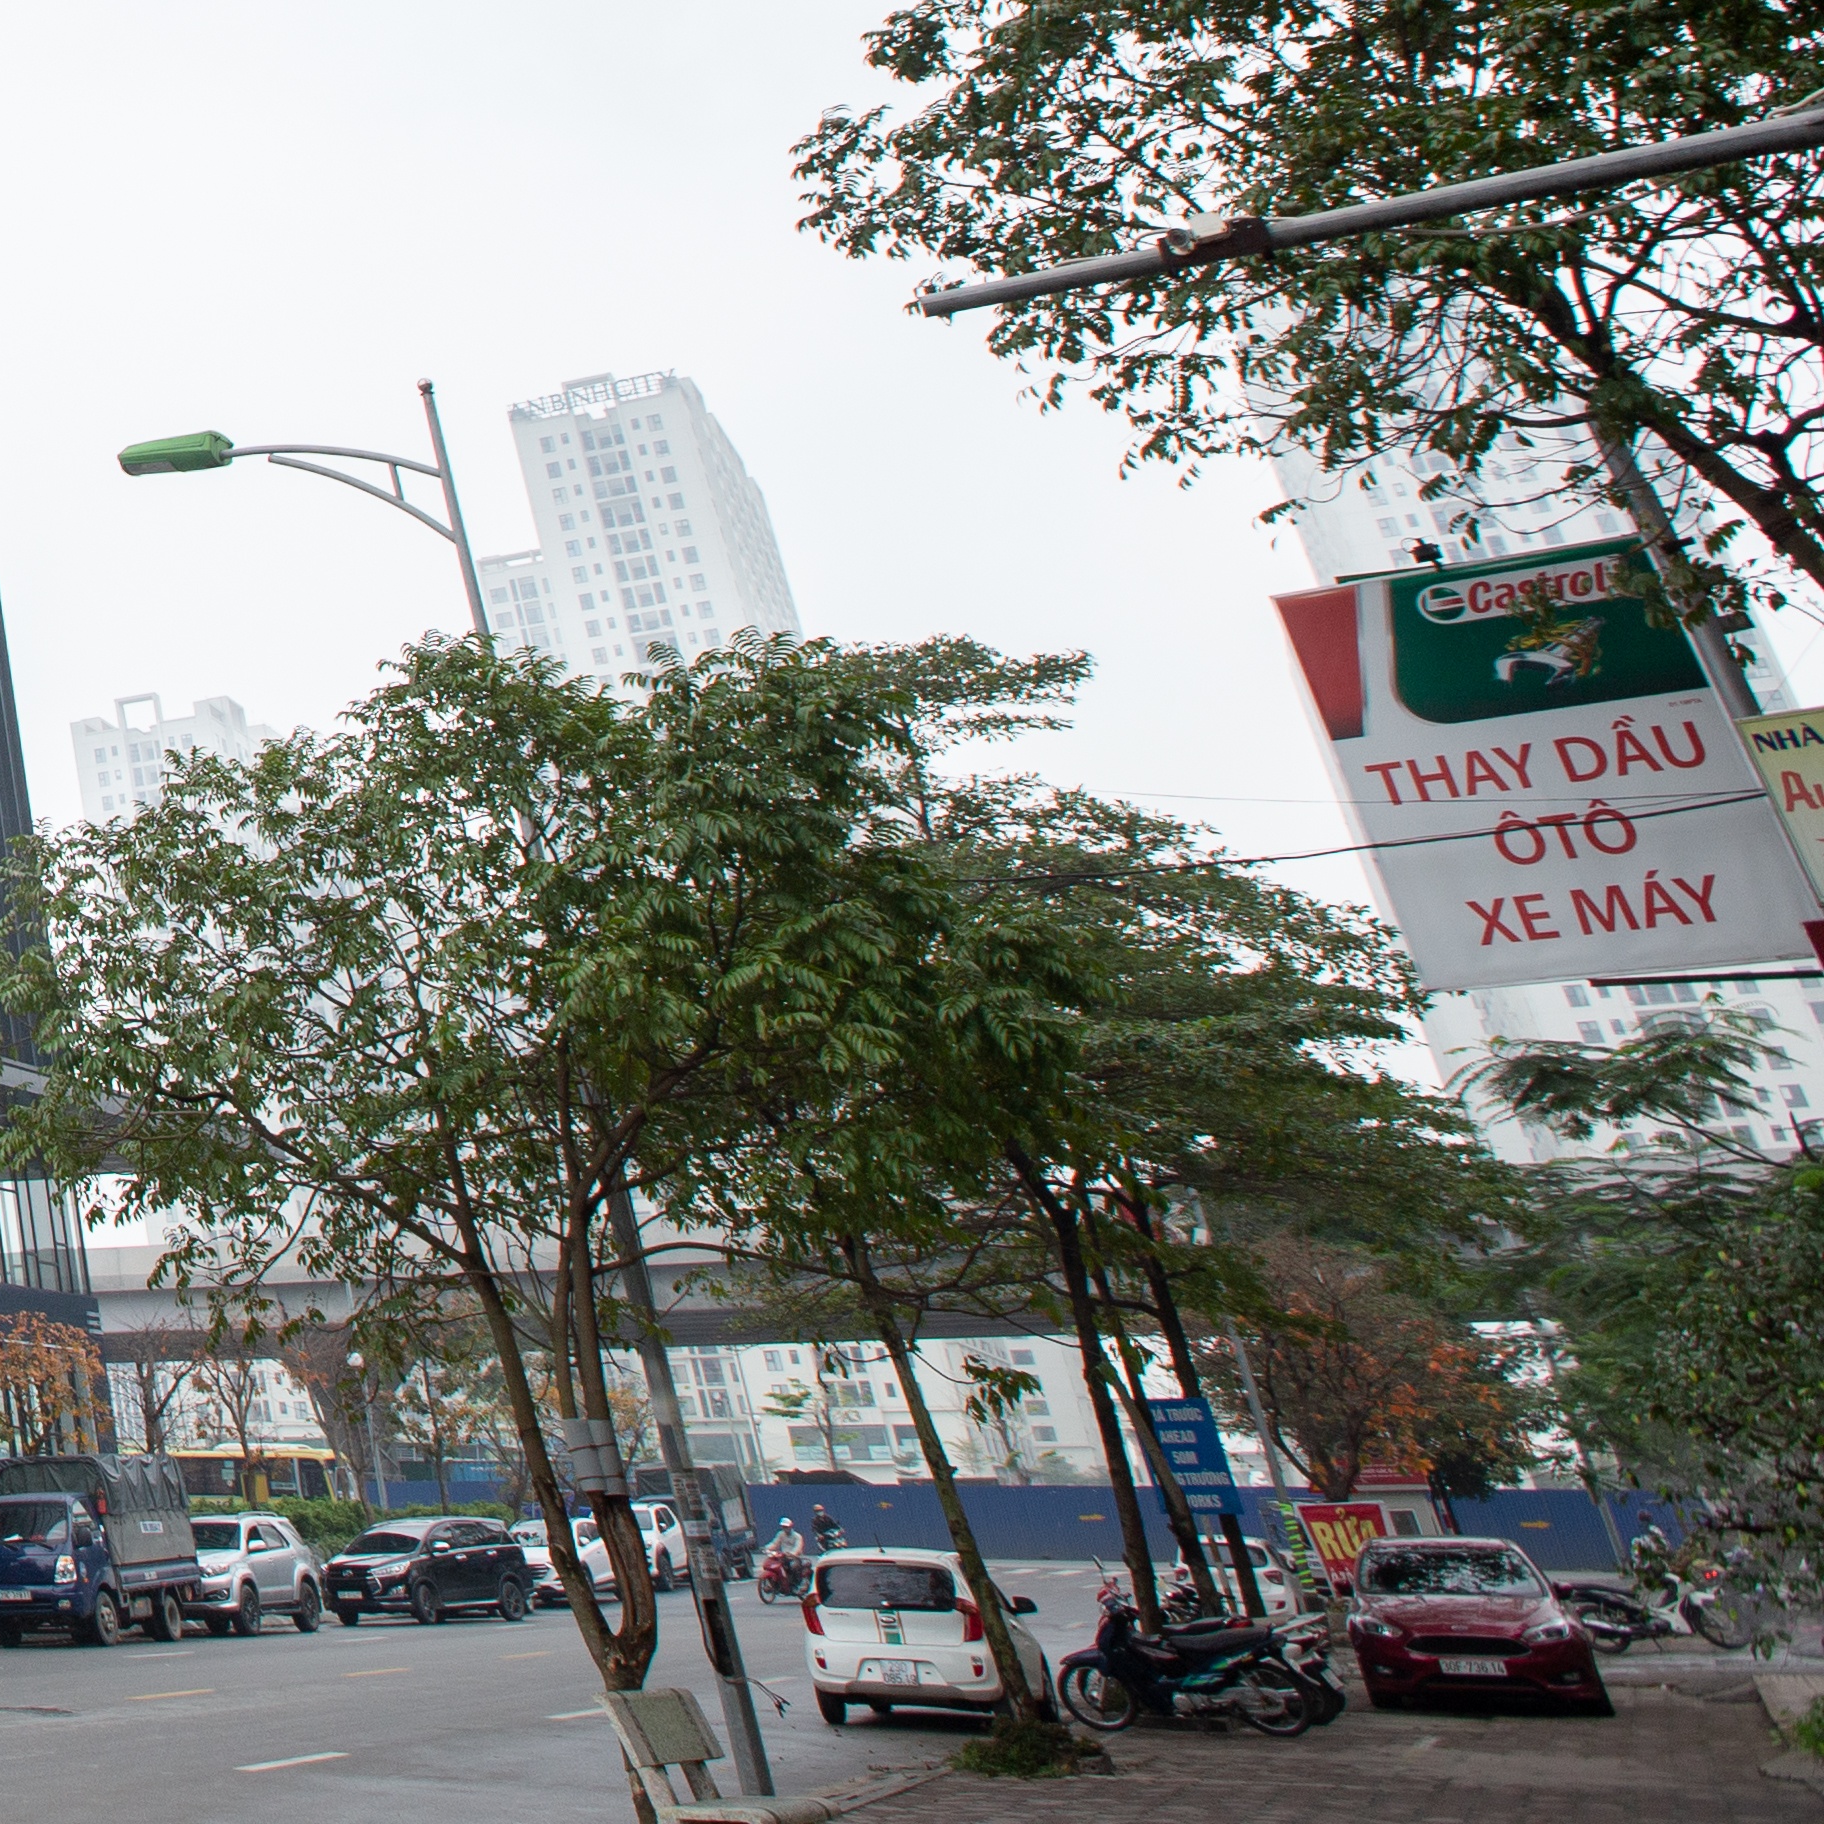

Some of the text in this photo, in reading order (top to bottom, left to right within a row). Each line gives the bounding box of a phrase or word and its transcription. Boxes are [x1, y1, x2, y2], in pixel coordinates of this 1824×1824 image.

[1364, 716, 1707, 805] THAY DẦU
[1751, 722, 1824, 753] NHÀ
[1492, 799, 1638, 866] ÔTÔ
[1466, 870, 1716, 946] XE MÁY
